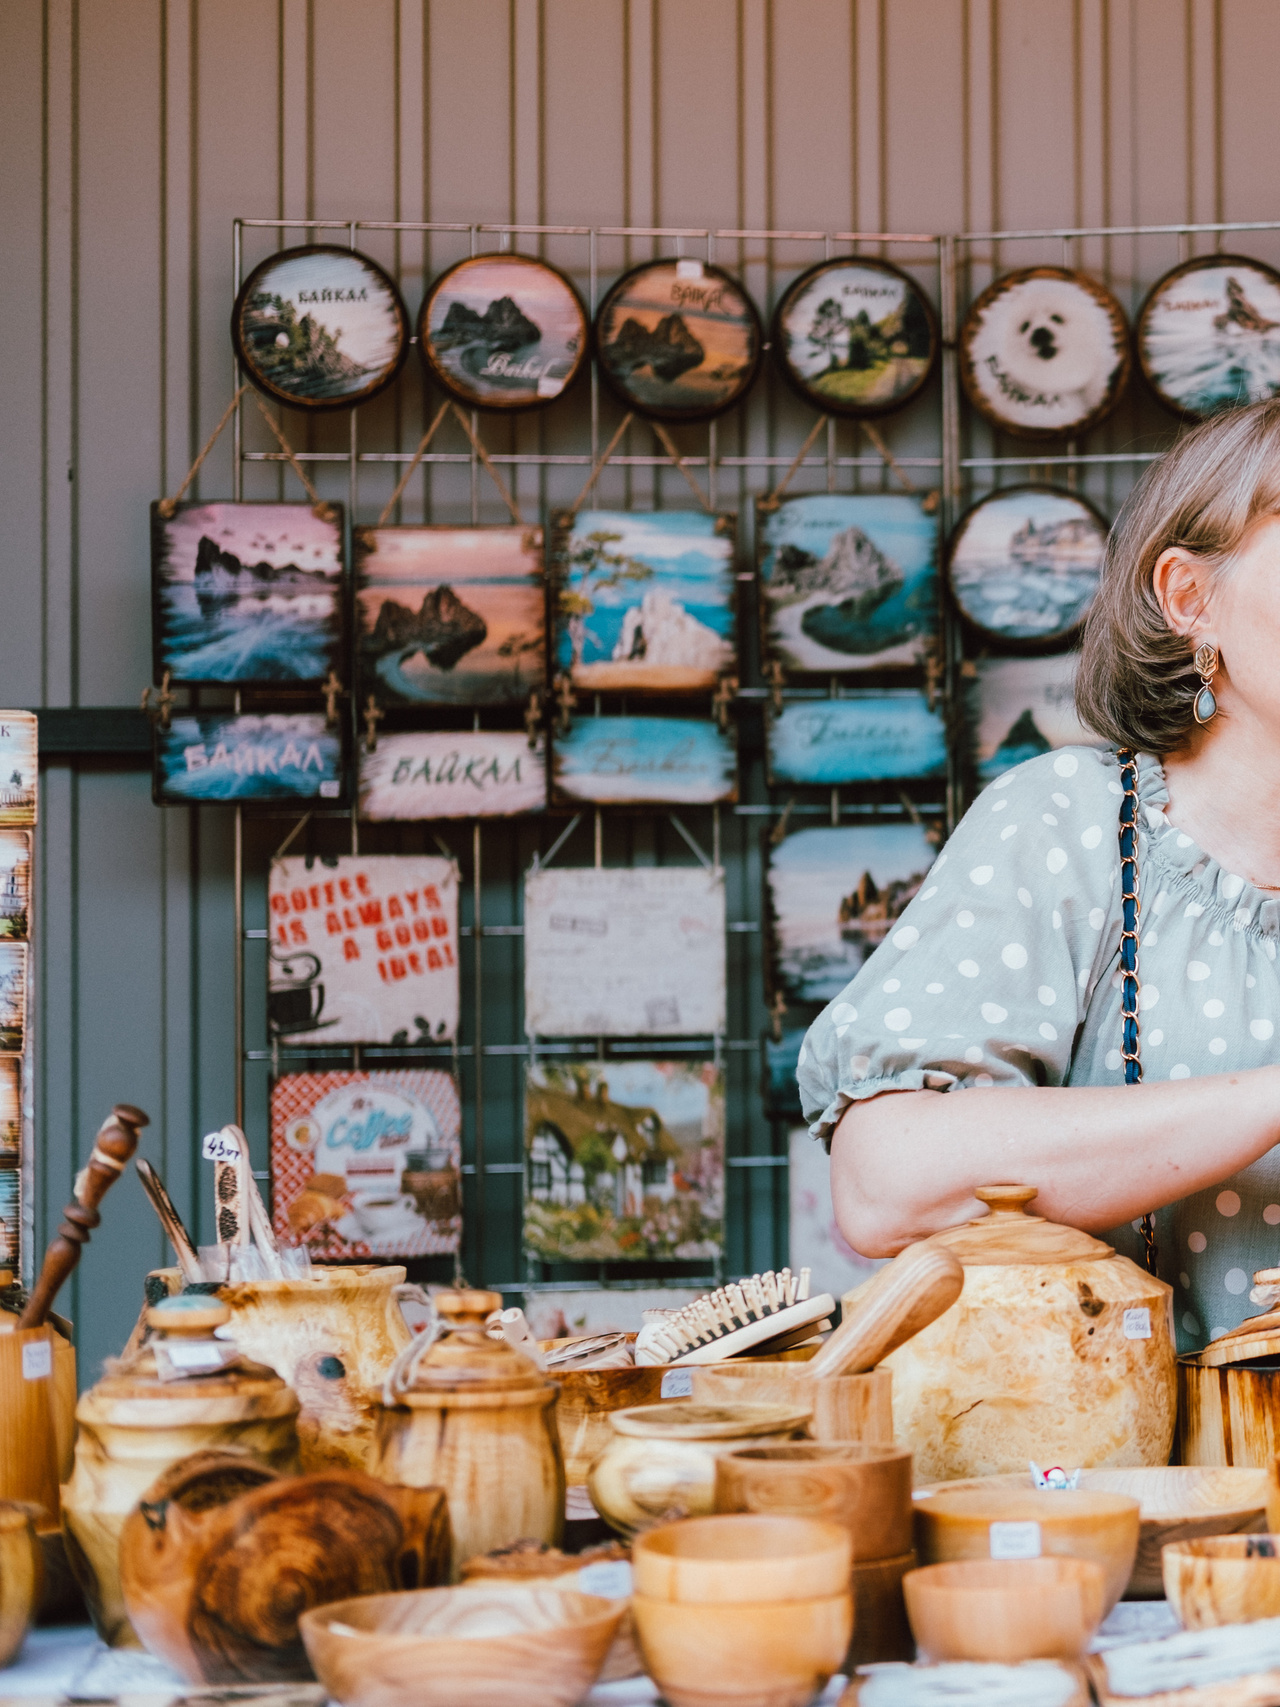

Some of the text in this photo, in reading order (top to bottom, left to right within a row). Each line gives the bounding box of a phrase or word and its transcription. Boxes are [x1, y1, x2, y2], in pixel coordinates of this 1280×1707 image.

[184, 743, 325, 775] БАЙКАЛ
[392, 751, 521, 791] БАЙКАЛ
[271, 872, 370, 915] COFFEE
[278, 885, 441, 945] IS ALWAYS
[344, 917, 448, 962] A GOOD
[326, 1111, 412, 1151] Coffee
